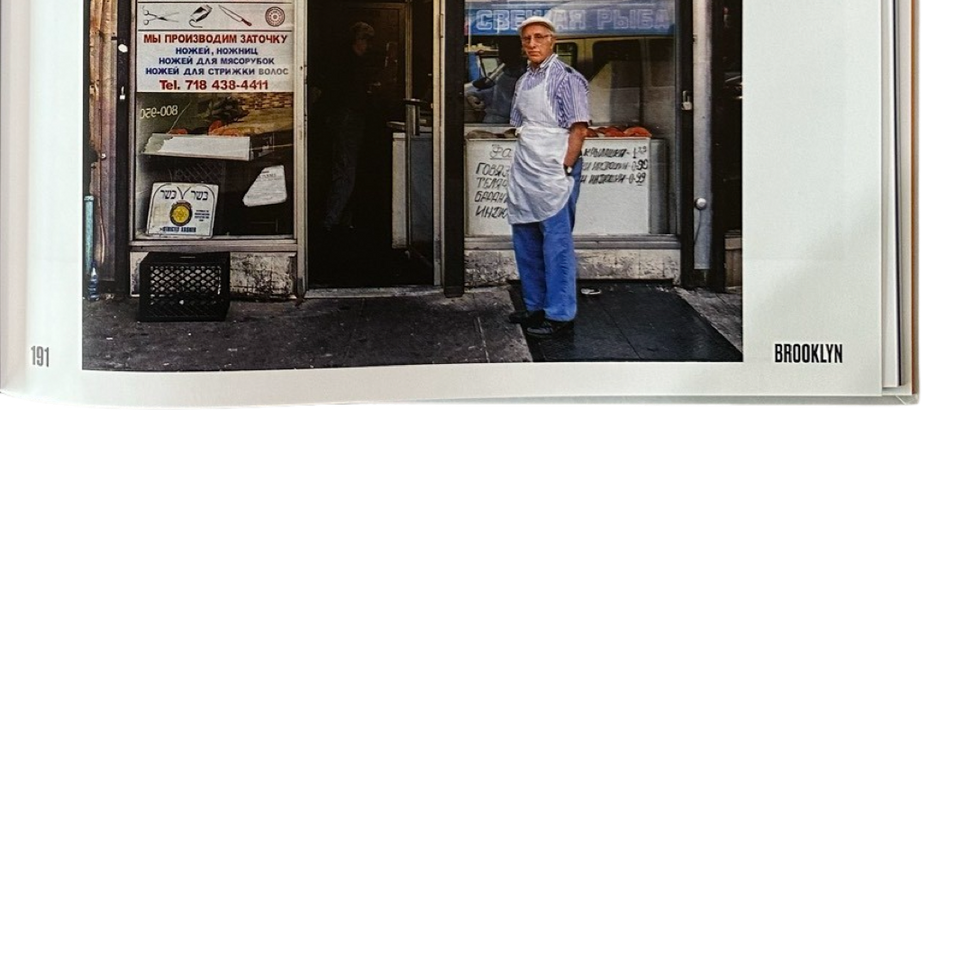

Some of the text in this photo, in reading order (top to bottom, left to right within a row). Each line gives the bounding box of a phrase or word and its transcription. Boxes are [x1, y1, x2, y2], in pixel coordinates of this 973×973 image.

[597, 9, 670, 30] РЫБА
[143, 34, 288, 44] МЫ ПРОИЗВОДИМ ЗАТОЧКУ
[216, 47, 258, 55] НОЖНИЦ
[159, 56, 193, 65] НОЖЕЙ
[196, 58, 218, 66] ДЛЯ
[145, 67, 179, 75] НОЖЕЙ
[183, 68, 205, 76] ДЛЯ
[159, 80, 269, 90] Tel. 718 438-4411
[31, 345, 50, 367] 191
[774, 343, 843, 363] BROOKLYN
